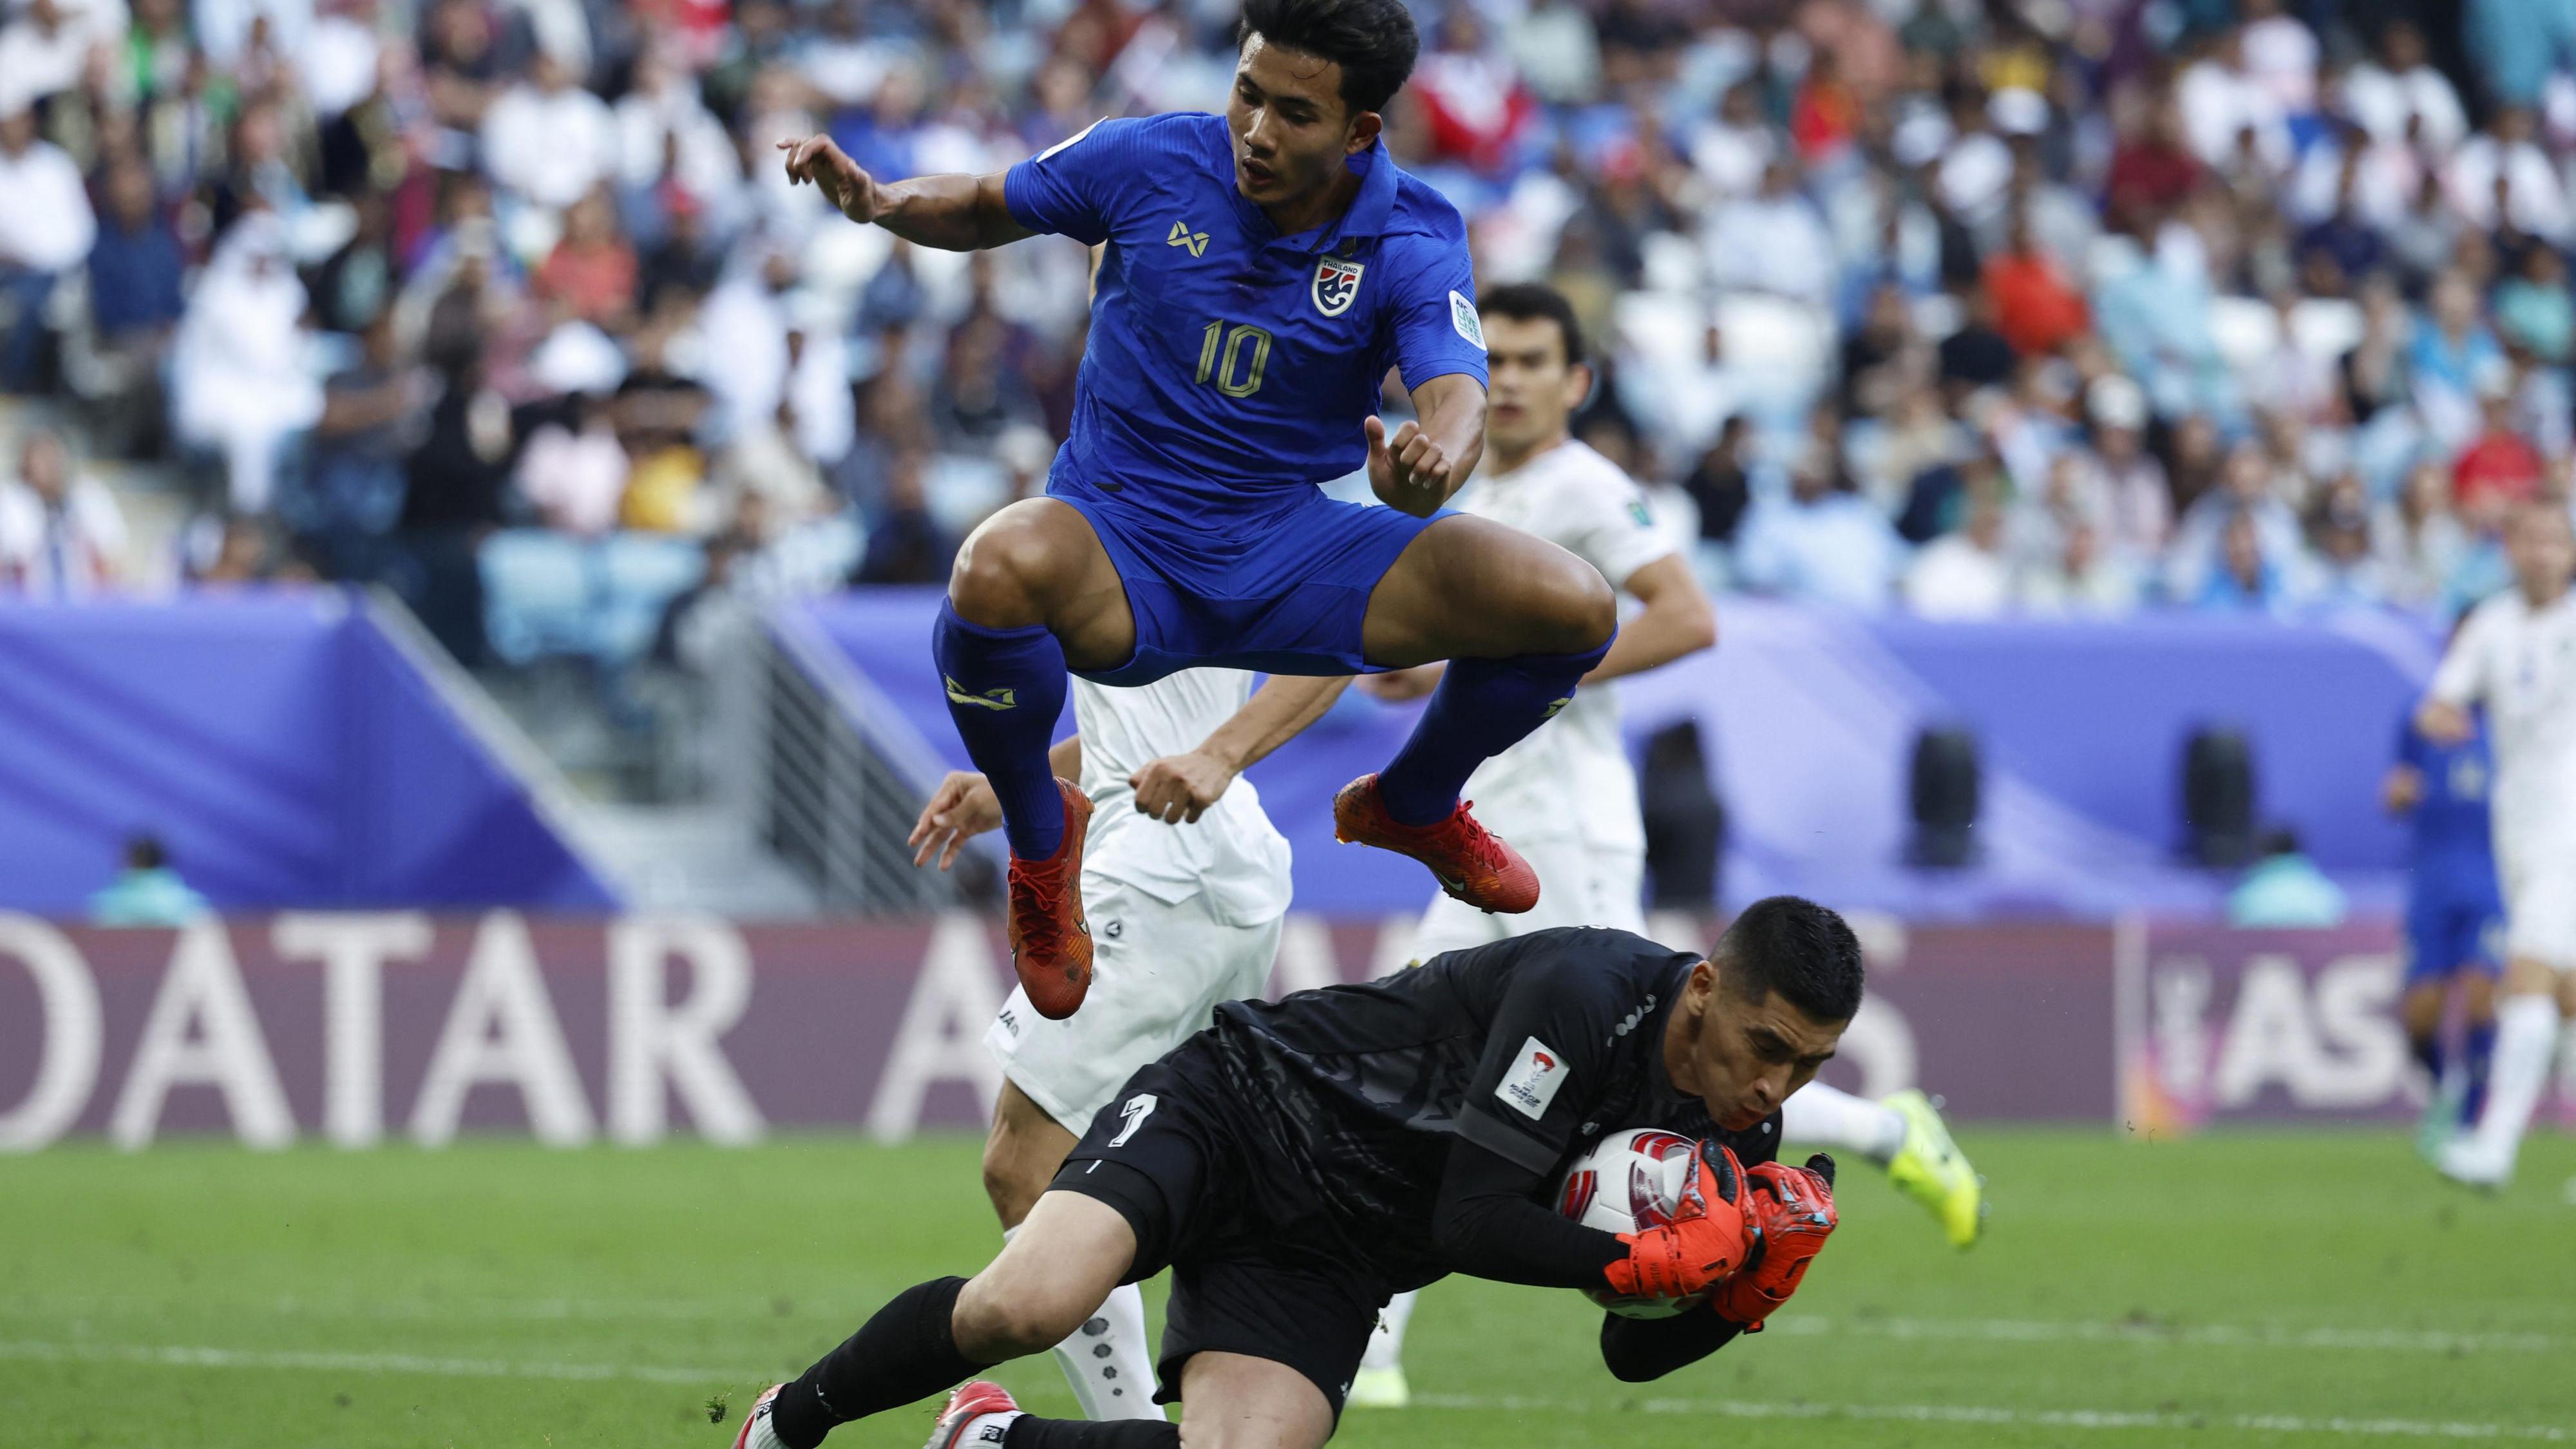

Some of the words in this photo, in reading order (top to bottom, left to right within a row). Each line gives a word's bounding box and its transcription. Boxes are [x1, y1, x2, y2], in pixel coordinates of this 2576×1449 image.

[1323, 260, 1358, 274] THAILAND
[1456, 299, 1469, 314] AFC
[1195, 319, 1273, 398] 10
